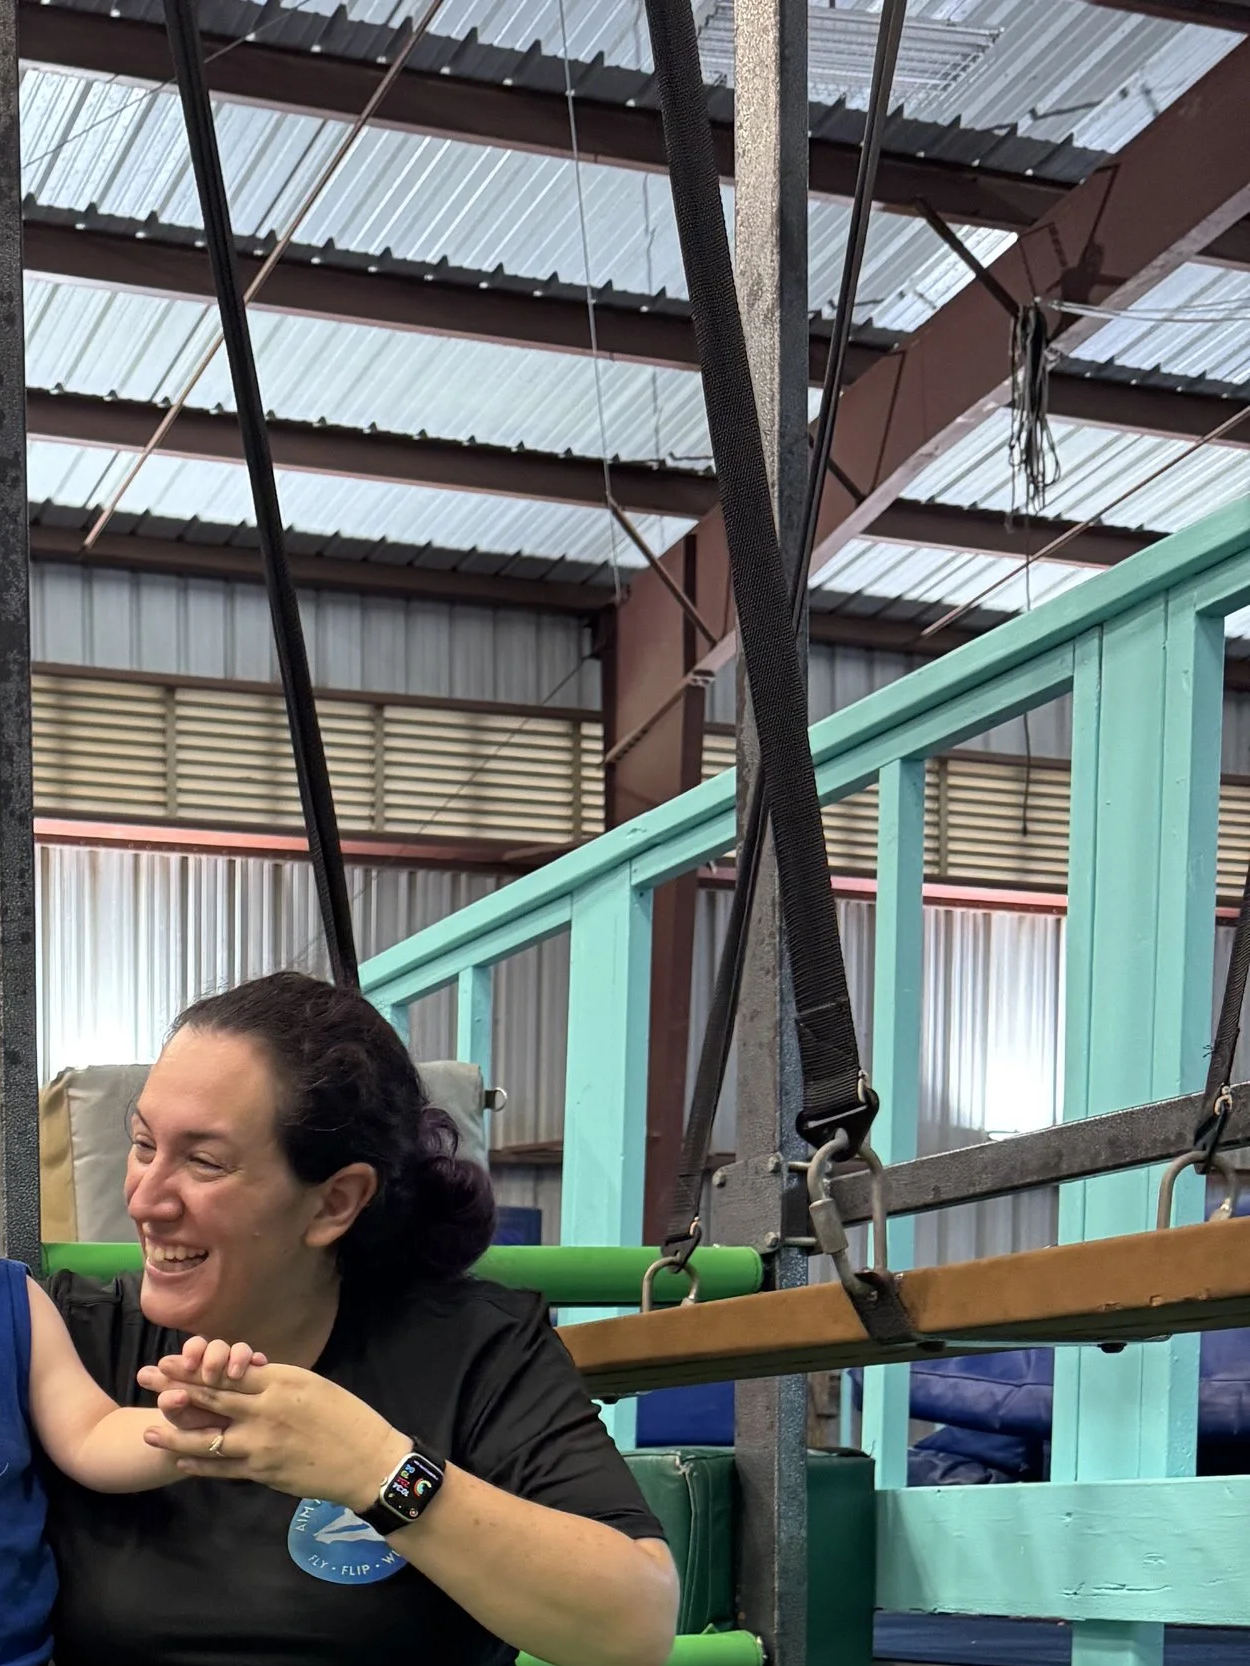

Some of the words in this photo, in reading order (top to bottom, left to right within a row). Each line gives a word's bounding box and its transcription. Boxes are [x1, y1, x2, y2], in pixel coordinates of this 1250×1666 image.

[295, 1506, 314, 1532] AIM
[308, 1554, 329, 1569] FLY
[341, 1564, 371, 1576] FLIP
